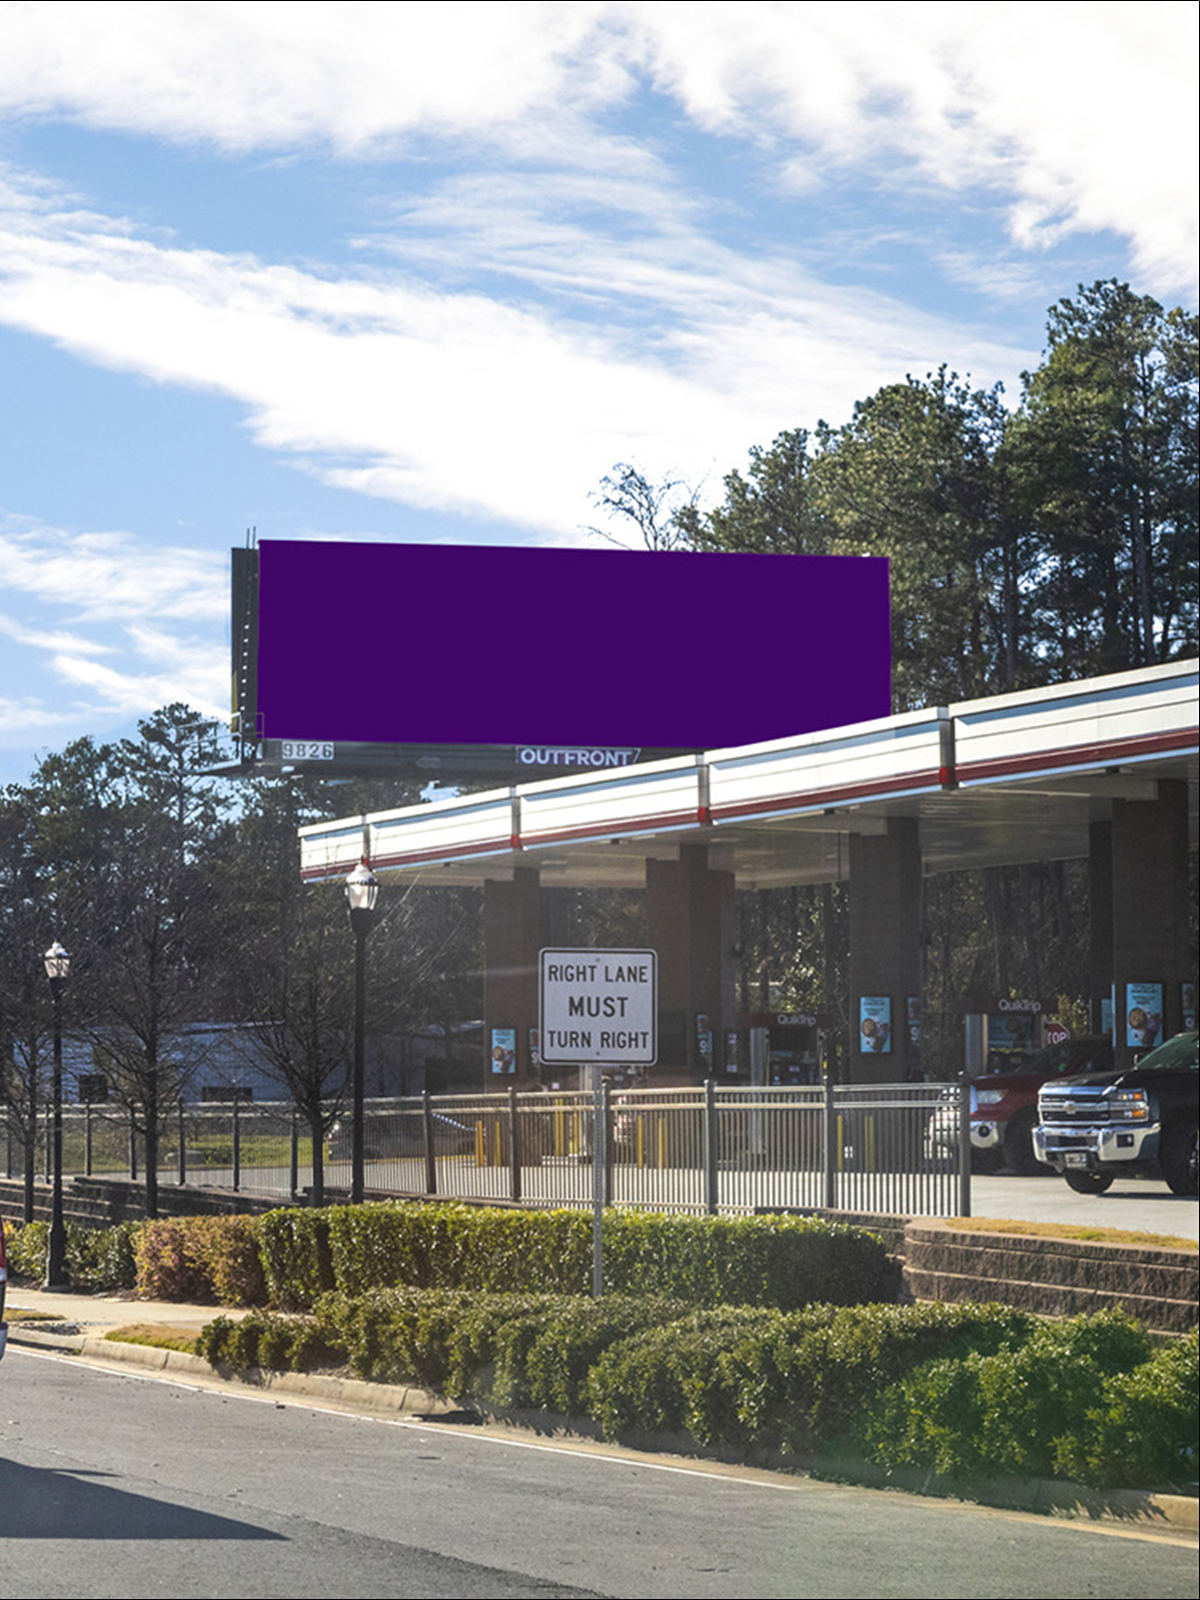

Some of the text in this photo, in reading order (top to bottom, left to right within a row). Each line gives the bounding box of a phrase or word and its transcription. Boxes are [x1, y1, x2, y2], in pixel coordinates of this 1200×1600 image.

[283, 742, 333, 758] 9826
[520, 748, 632, 766] OUTFRONT
[548, 964, 648, 983] RIGHT LANE
[568, 996, 628, 1018] MUST
[998, 998, 1042, 1014] QuikTrip
[777, 1014, 817, 1028] QuikTrip
[547, 1030, 649, 1049] TURN RIGHT
[1047, 1030, 1068, 1045] TOP
